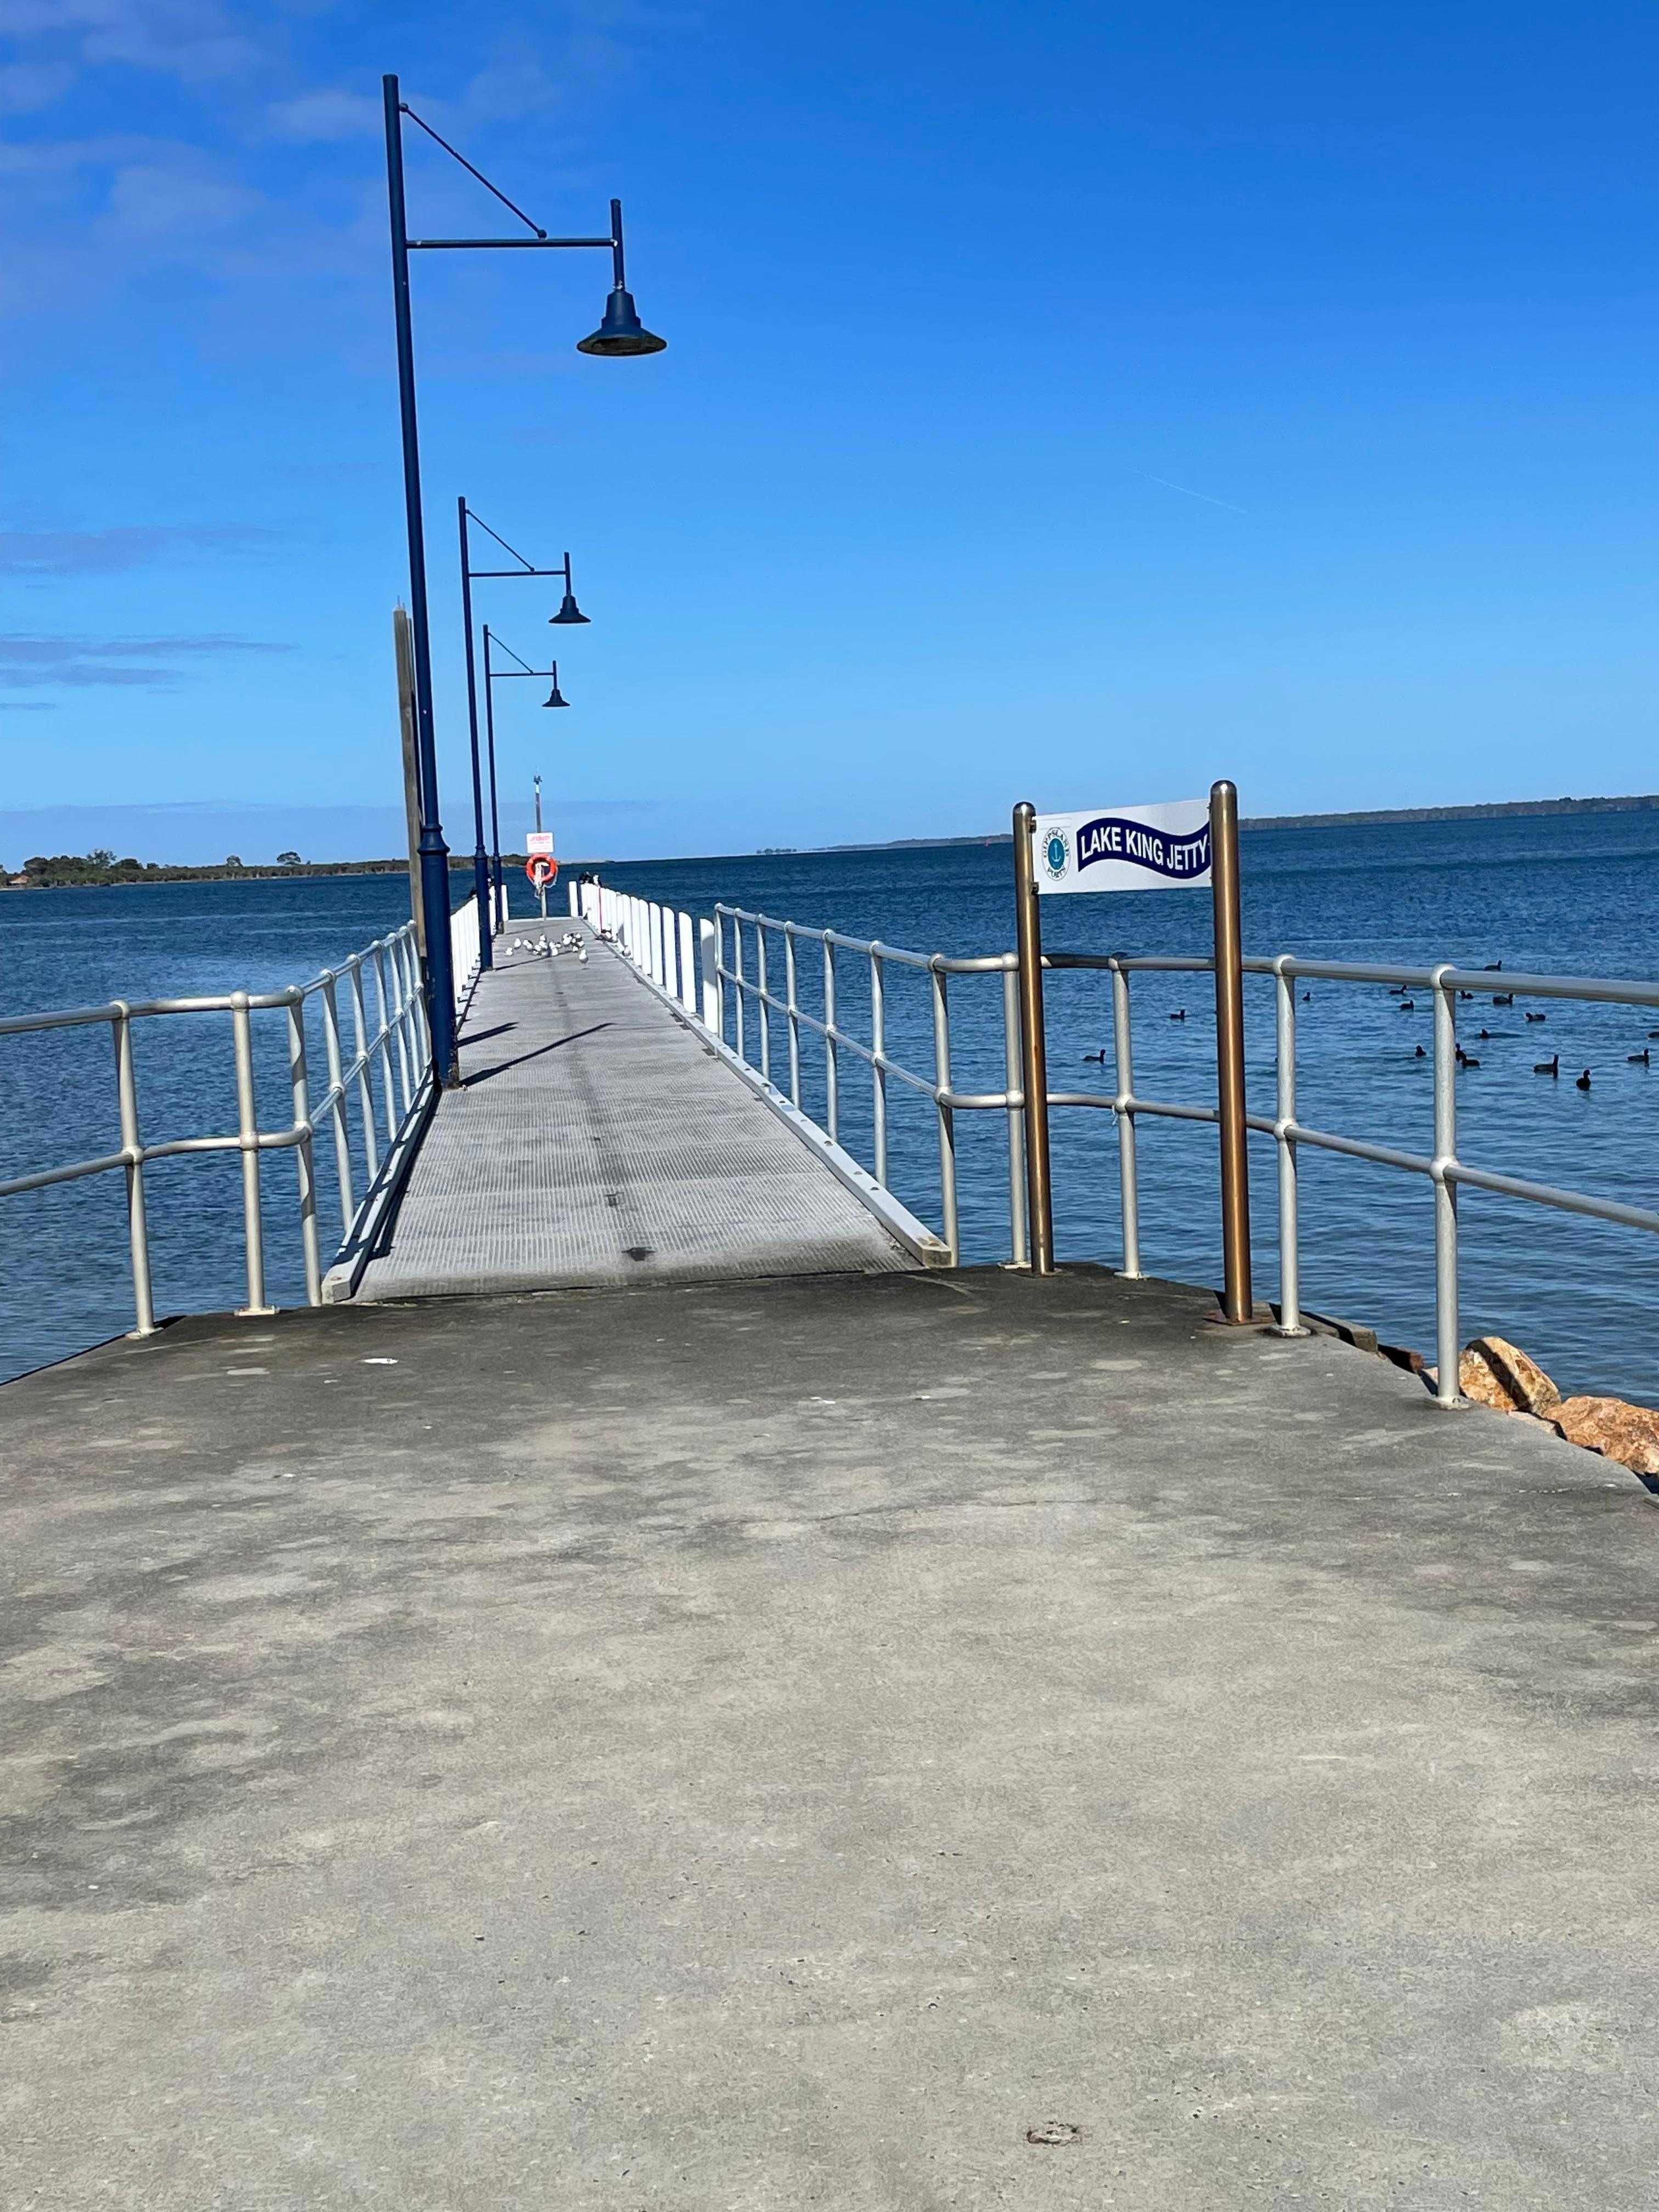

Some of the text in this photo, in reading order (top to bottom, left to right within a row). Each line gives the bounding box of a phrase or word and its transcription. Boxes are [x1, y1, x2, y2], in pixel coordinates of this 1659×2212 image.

[1081, 827, 1207, 871] LAKE KING JETTY
